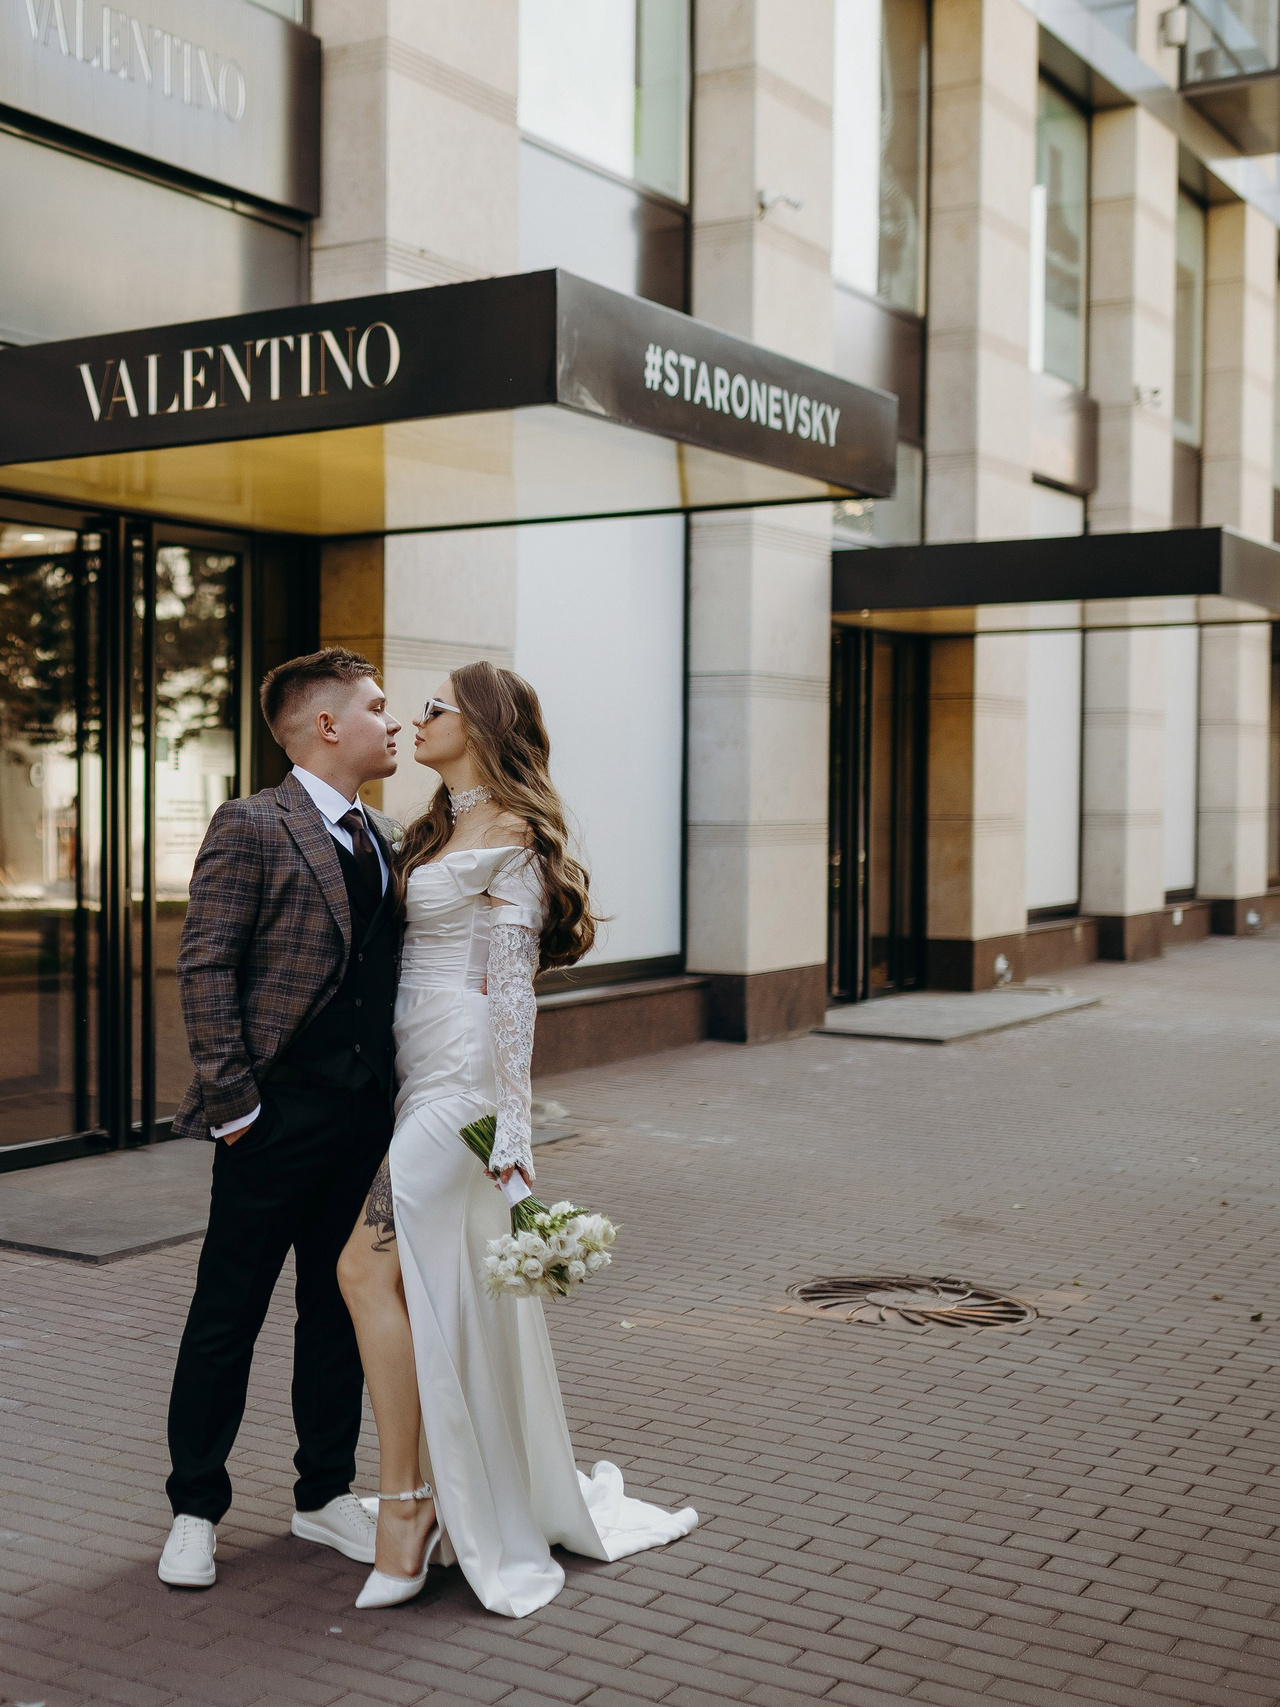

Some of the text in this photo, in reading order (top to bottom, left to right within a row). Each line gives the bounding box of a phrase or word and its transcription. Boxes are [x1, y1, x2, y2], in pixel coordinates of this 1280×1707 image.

[24, 0, 247, 122] VALENTINO
[76, 321, 401, 422] VALENTINO
[644, 343, 841, 447] #STARONEVSKY
